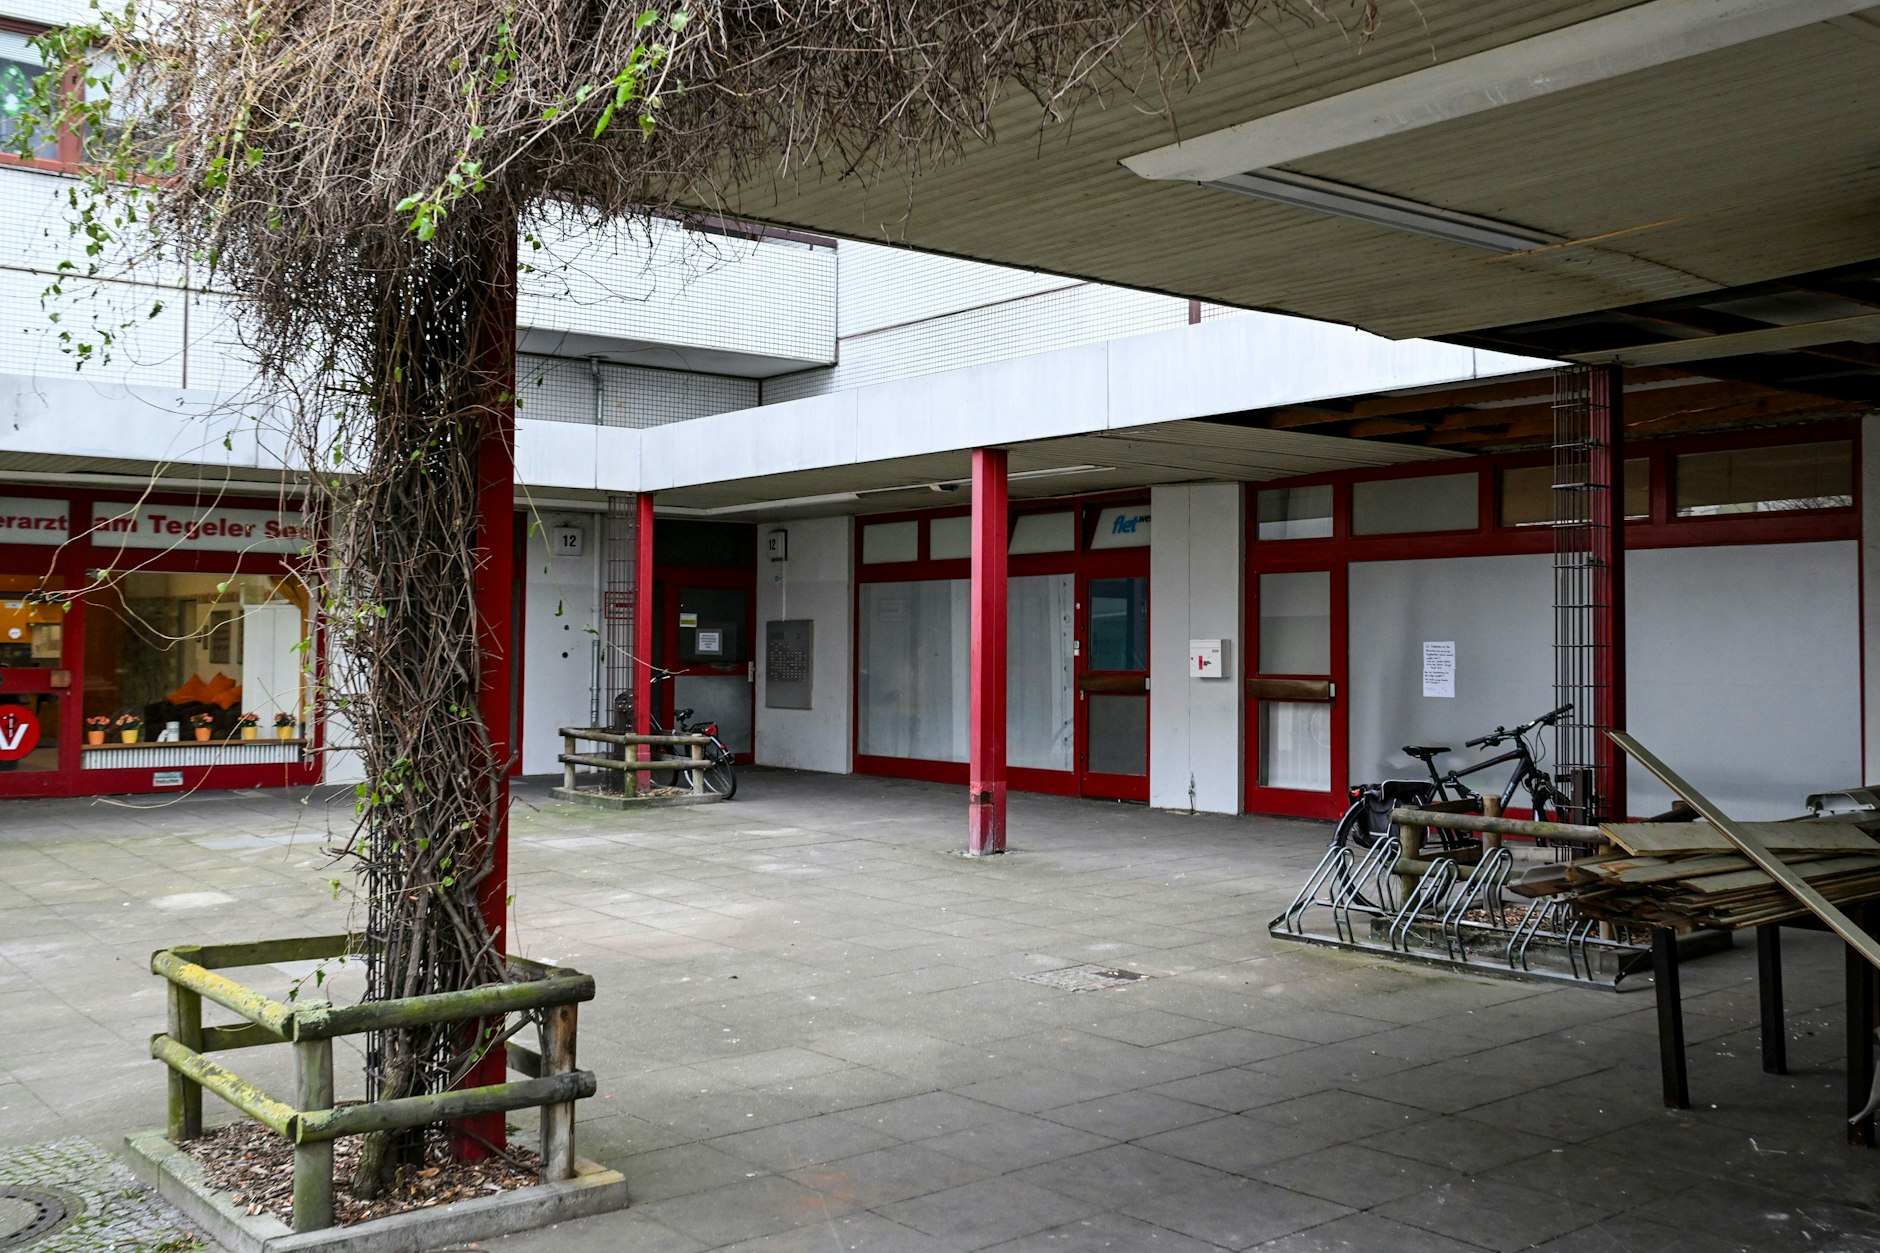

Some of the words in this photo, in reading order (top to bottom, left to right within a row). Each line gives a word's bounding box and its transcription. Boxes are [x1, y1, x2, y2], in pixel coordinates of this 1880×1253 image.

[94, 516, 138, 533] am
[147, 514, 256, 540] Tegeler
[562, 534, 577, 548] 12
[768, 538, 776, 551] 12
